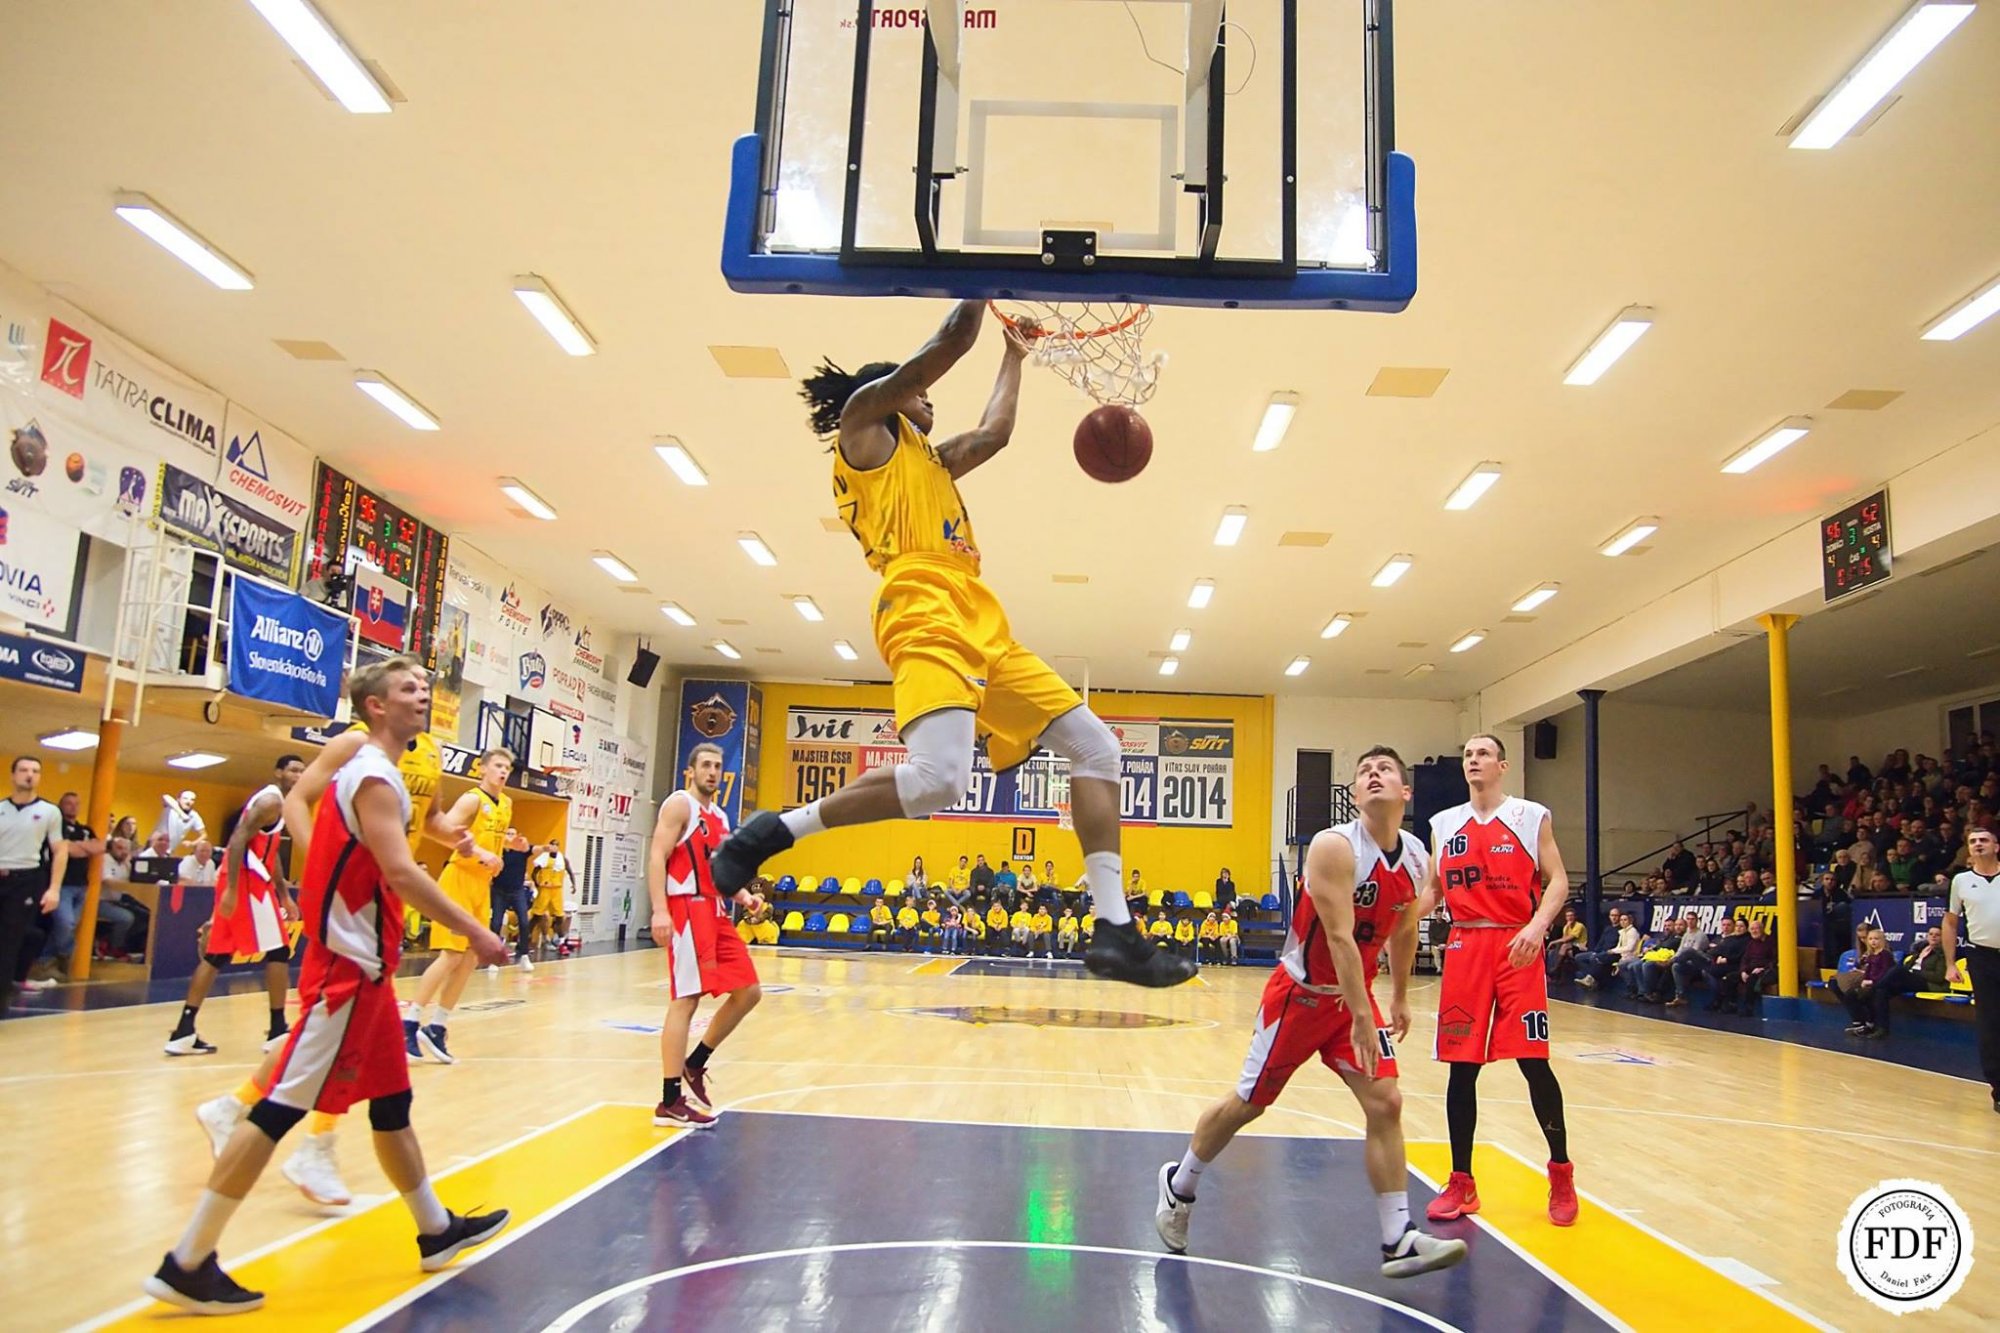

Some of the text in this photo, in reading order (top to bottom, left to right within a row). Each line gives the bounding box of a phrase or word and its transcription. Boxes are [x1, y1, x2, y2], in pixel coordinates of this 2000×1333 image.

[229, 468, 307, 517] CHEMOSVIT
[250, 614, 305, 650] Allianz
[794, 715, 855, 739] Svit
[792, 749, 829, 763] MAJSTER
[1189, 738, 1231, 751] SVIT
[797, 765, 847, 804] 1961
[1163, 775, 1227, 820] 2014
[1015, 829, 1033, 855] D
[1445, 834, 1469, 858] 16
[1521, 1010, 1549, 1042] 16
